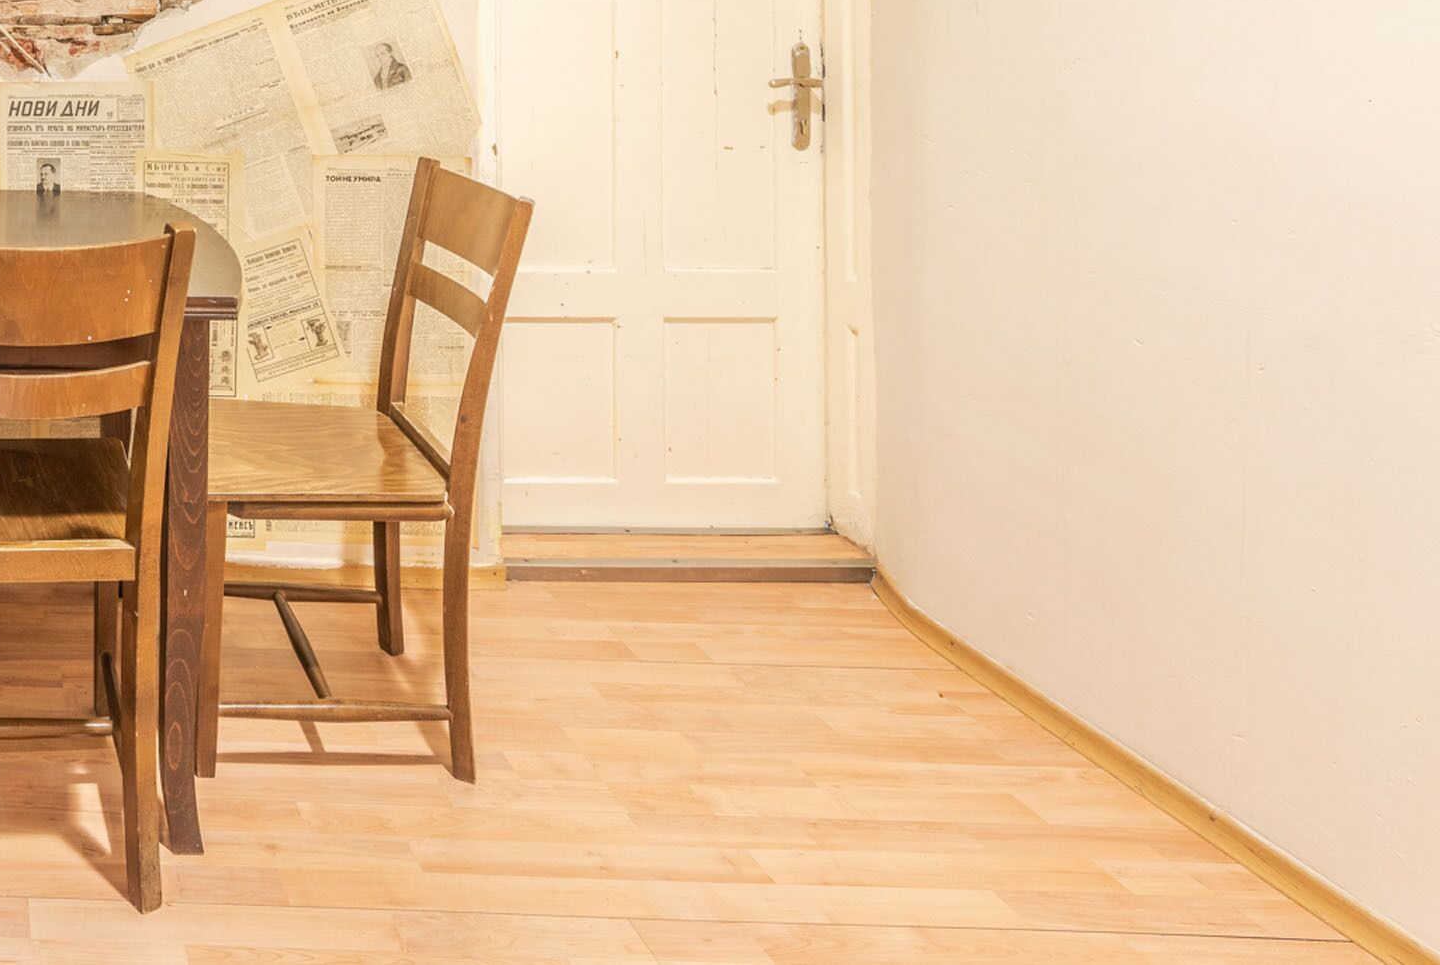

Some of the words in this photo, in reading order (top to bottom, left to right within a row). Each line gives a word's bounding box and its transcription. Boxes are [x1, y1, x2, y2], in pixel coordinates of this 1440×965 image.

[8, 100, 58, 117] НОВИ
[60, 100, 100, 117] ДНИ
[353, 175, 381, 183] УМИРА
